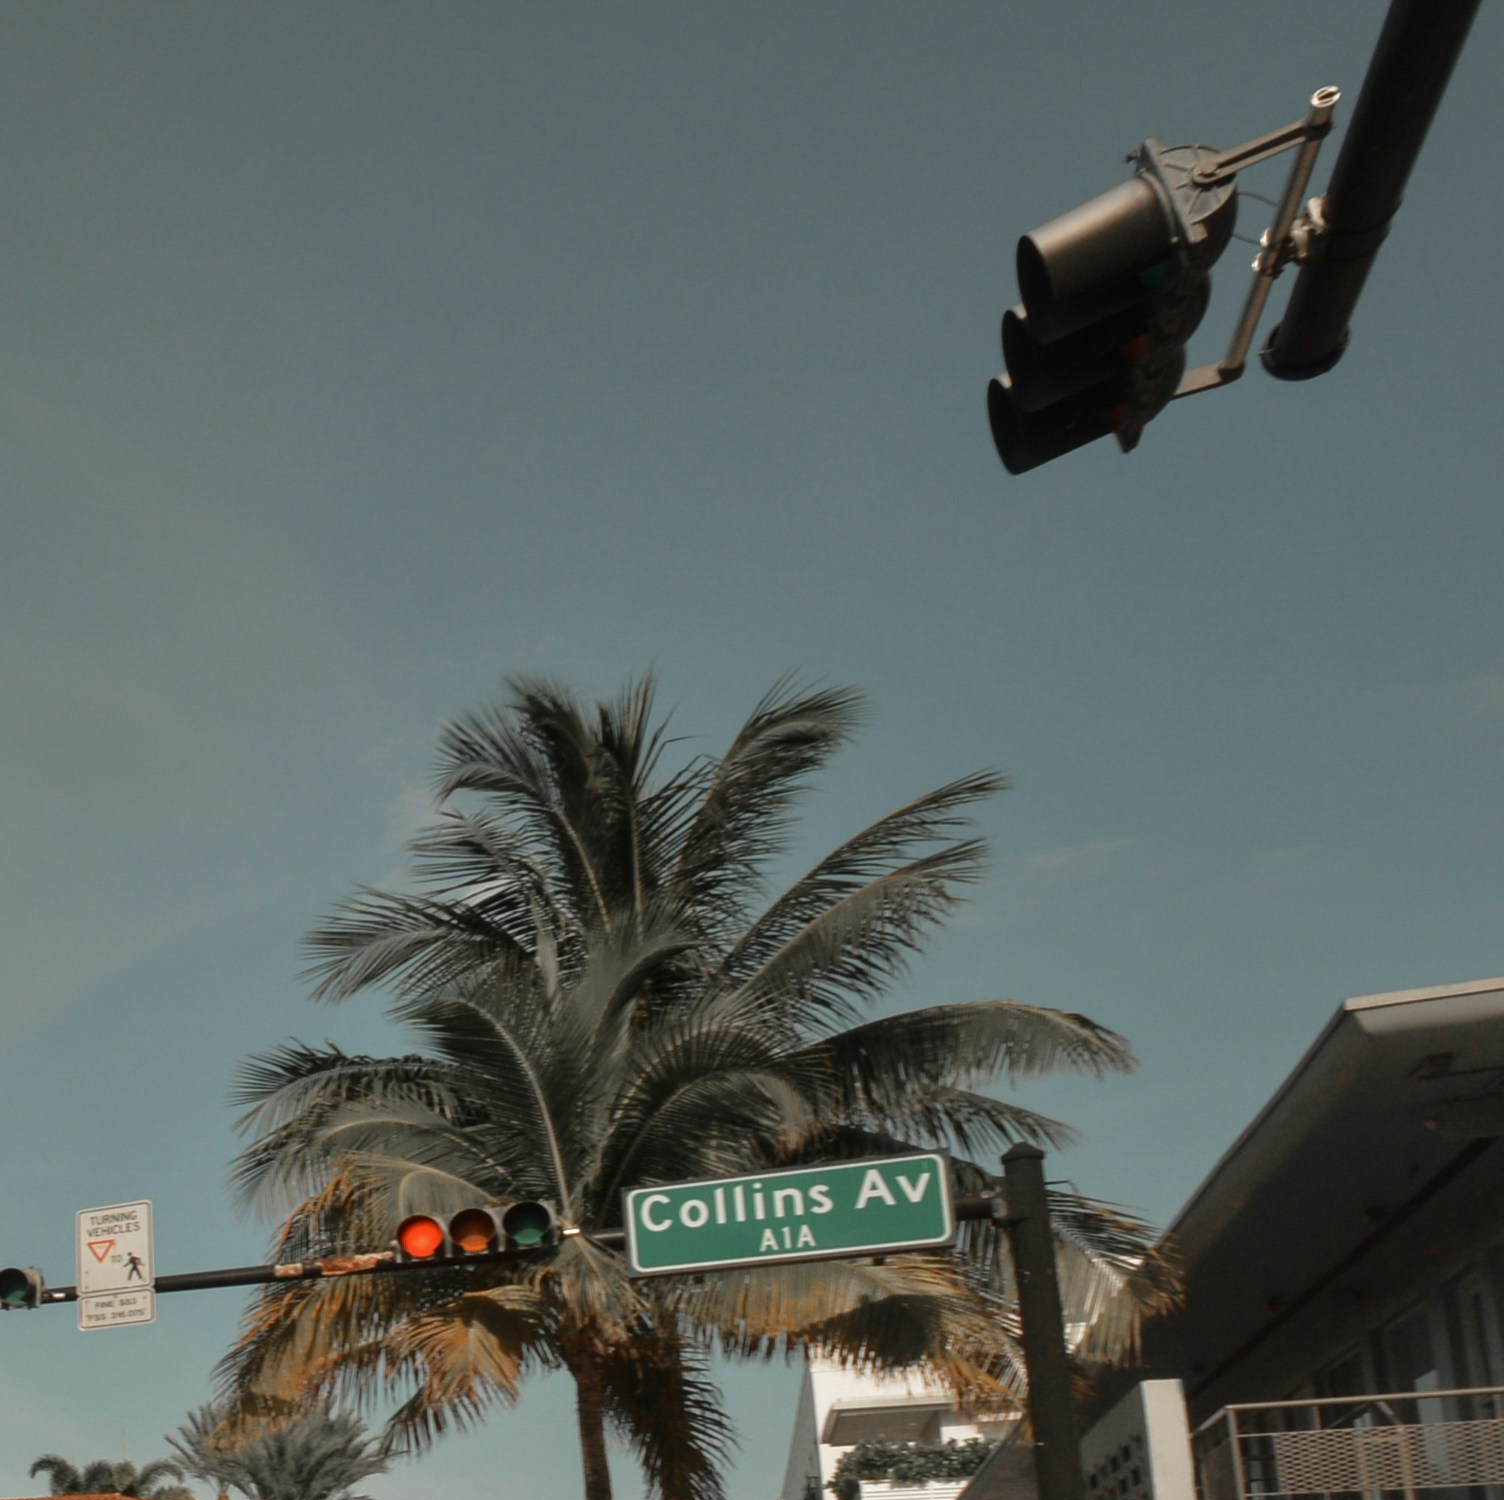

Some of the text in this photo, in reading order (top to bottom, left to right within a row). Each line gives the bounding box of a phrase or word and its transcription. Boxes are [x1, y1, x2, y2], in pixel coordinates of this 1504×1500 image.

[640, 1168, 931, 1232] Collins Av
[90, 1210, 138, 1226] TURNING
[87, 1221, 141, 1238] VEHICLES
[759, 1223, 817, 1251] A1A
[95, 1299, 114, 1309] FINE
